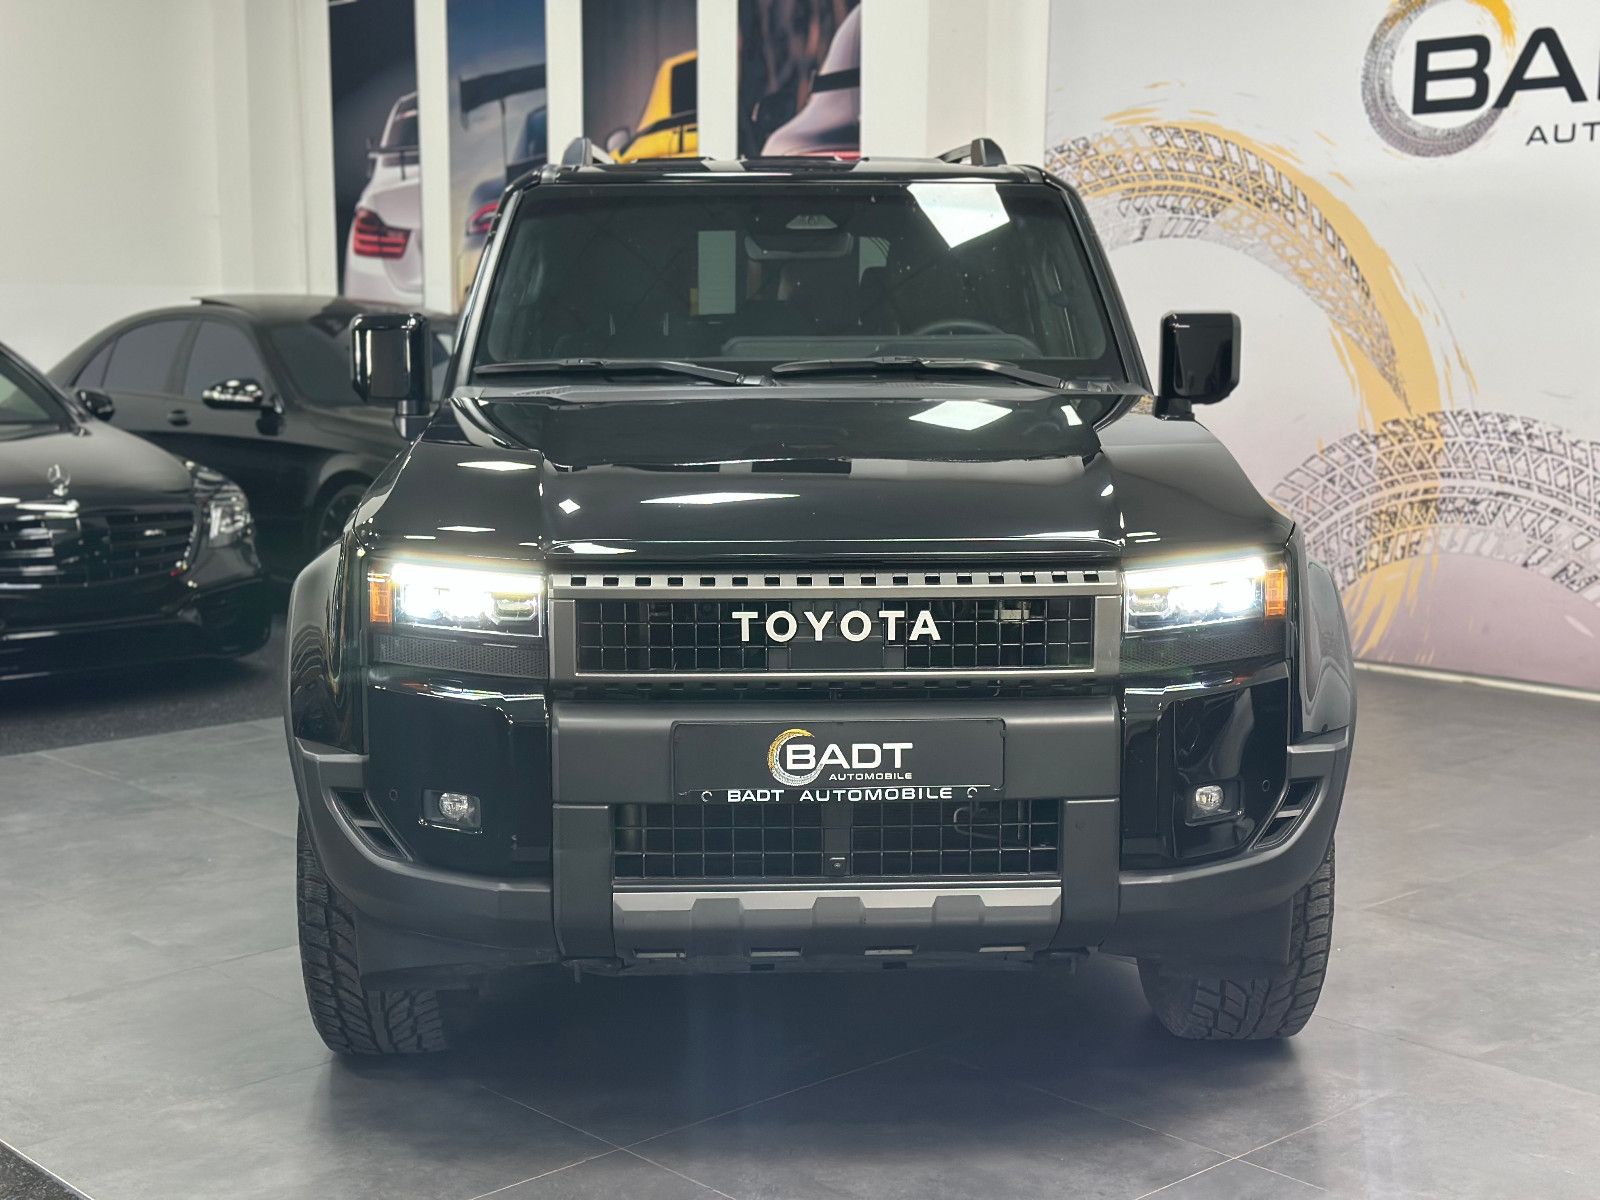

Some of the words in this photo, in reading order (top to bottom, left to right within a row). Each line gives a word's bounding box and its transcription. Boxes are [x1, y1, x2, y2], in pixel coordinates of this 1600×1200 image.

[1412, 27, 1600, 115] BA
[732, 610, 941, 642] TOYOTA
[786, 743, 913, 770] BADT
[829, 772, 912, 781] AUTOMOBILE
[727, 789, 784, 802] BADT
[800, 787, 952, 802] AUTOMOBILE
